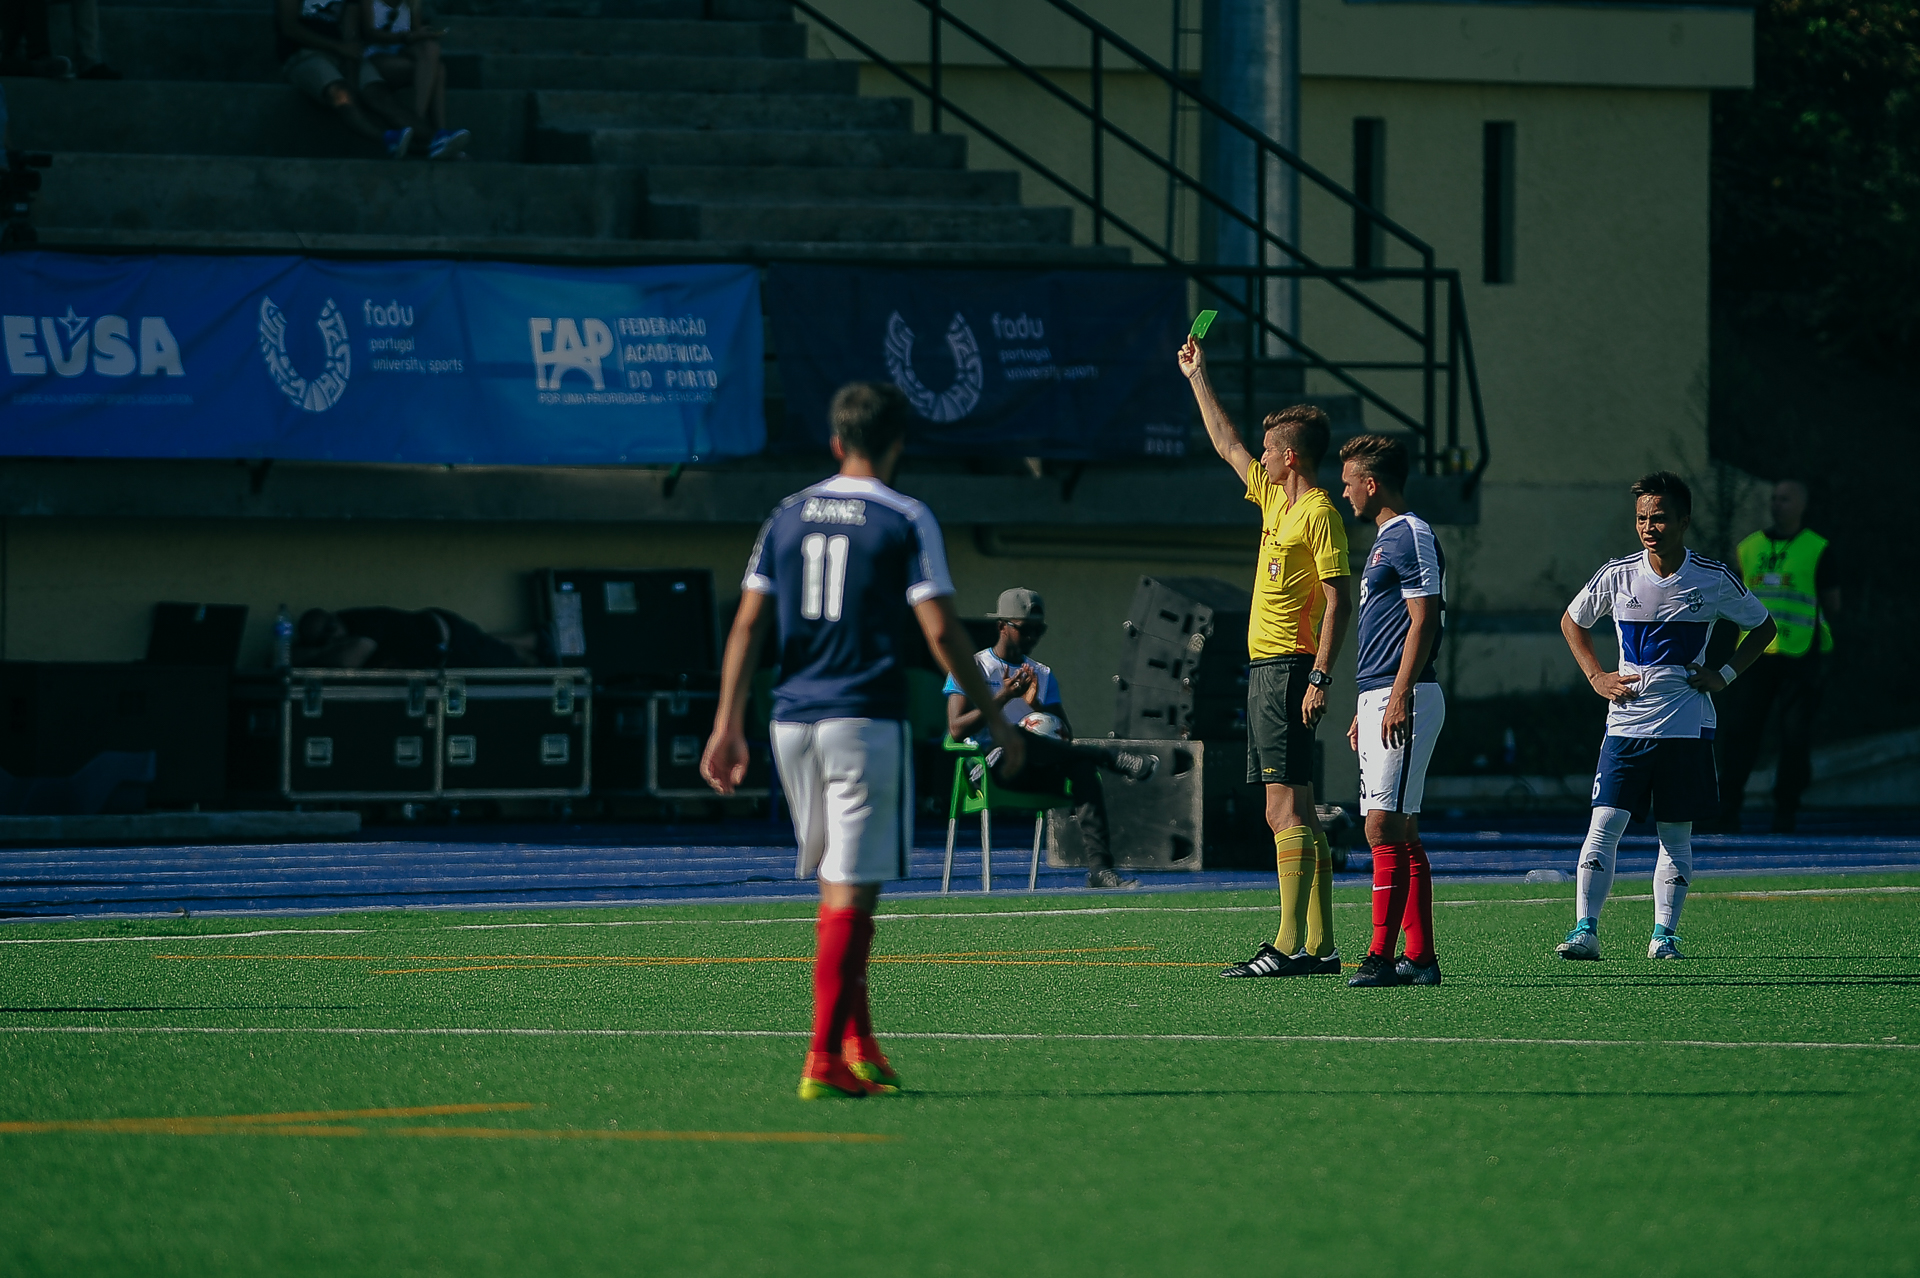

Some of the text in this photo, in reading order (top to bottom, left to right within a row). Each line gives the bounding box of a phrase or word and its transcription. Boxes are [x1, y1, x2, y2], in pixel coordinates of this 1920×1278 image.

[363, 298, 414, 327] fadu
[992, 312, 1044, 339] fadu
[3, 306, 186, 378] EUSA
[370, 338, 415, 354] portugal
[373, 357, 463, 373] university sports
[1000, 348, 1052, 364] portugal
[628, 369, 718, 389] DO PORTO
[801, 533, 850, 622] 11
[1592, 772, 1602, 800] 6
